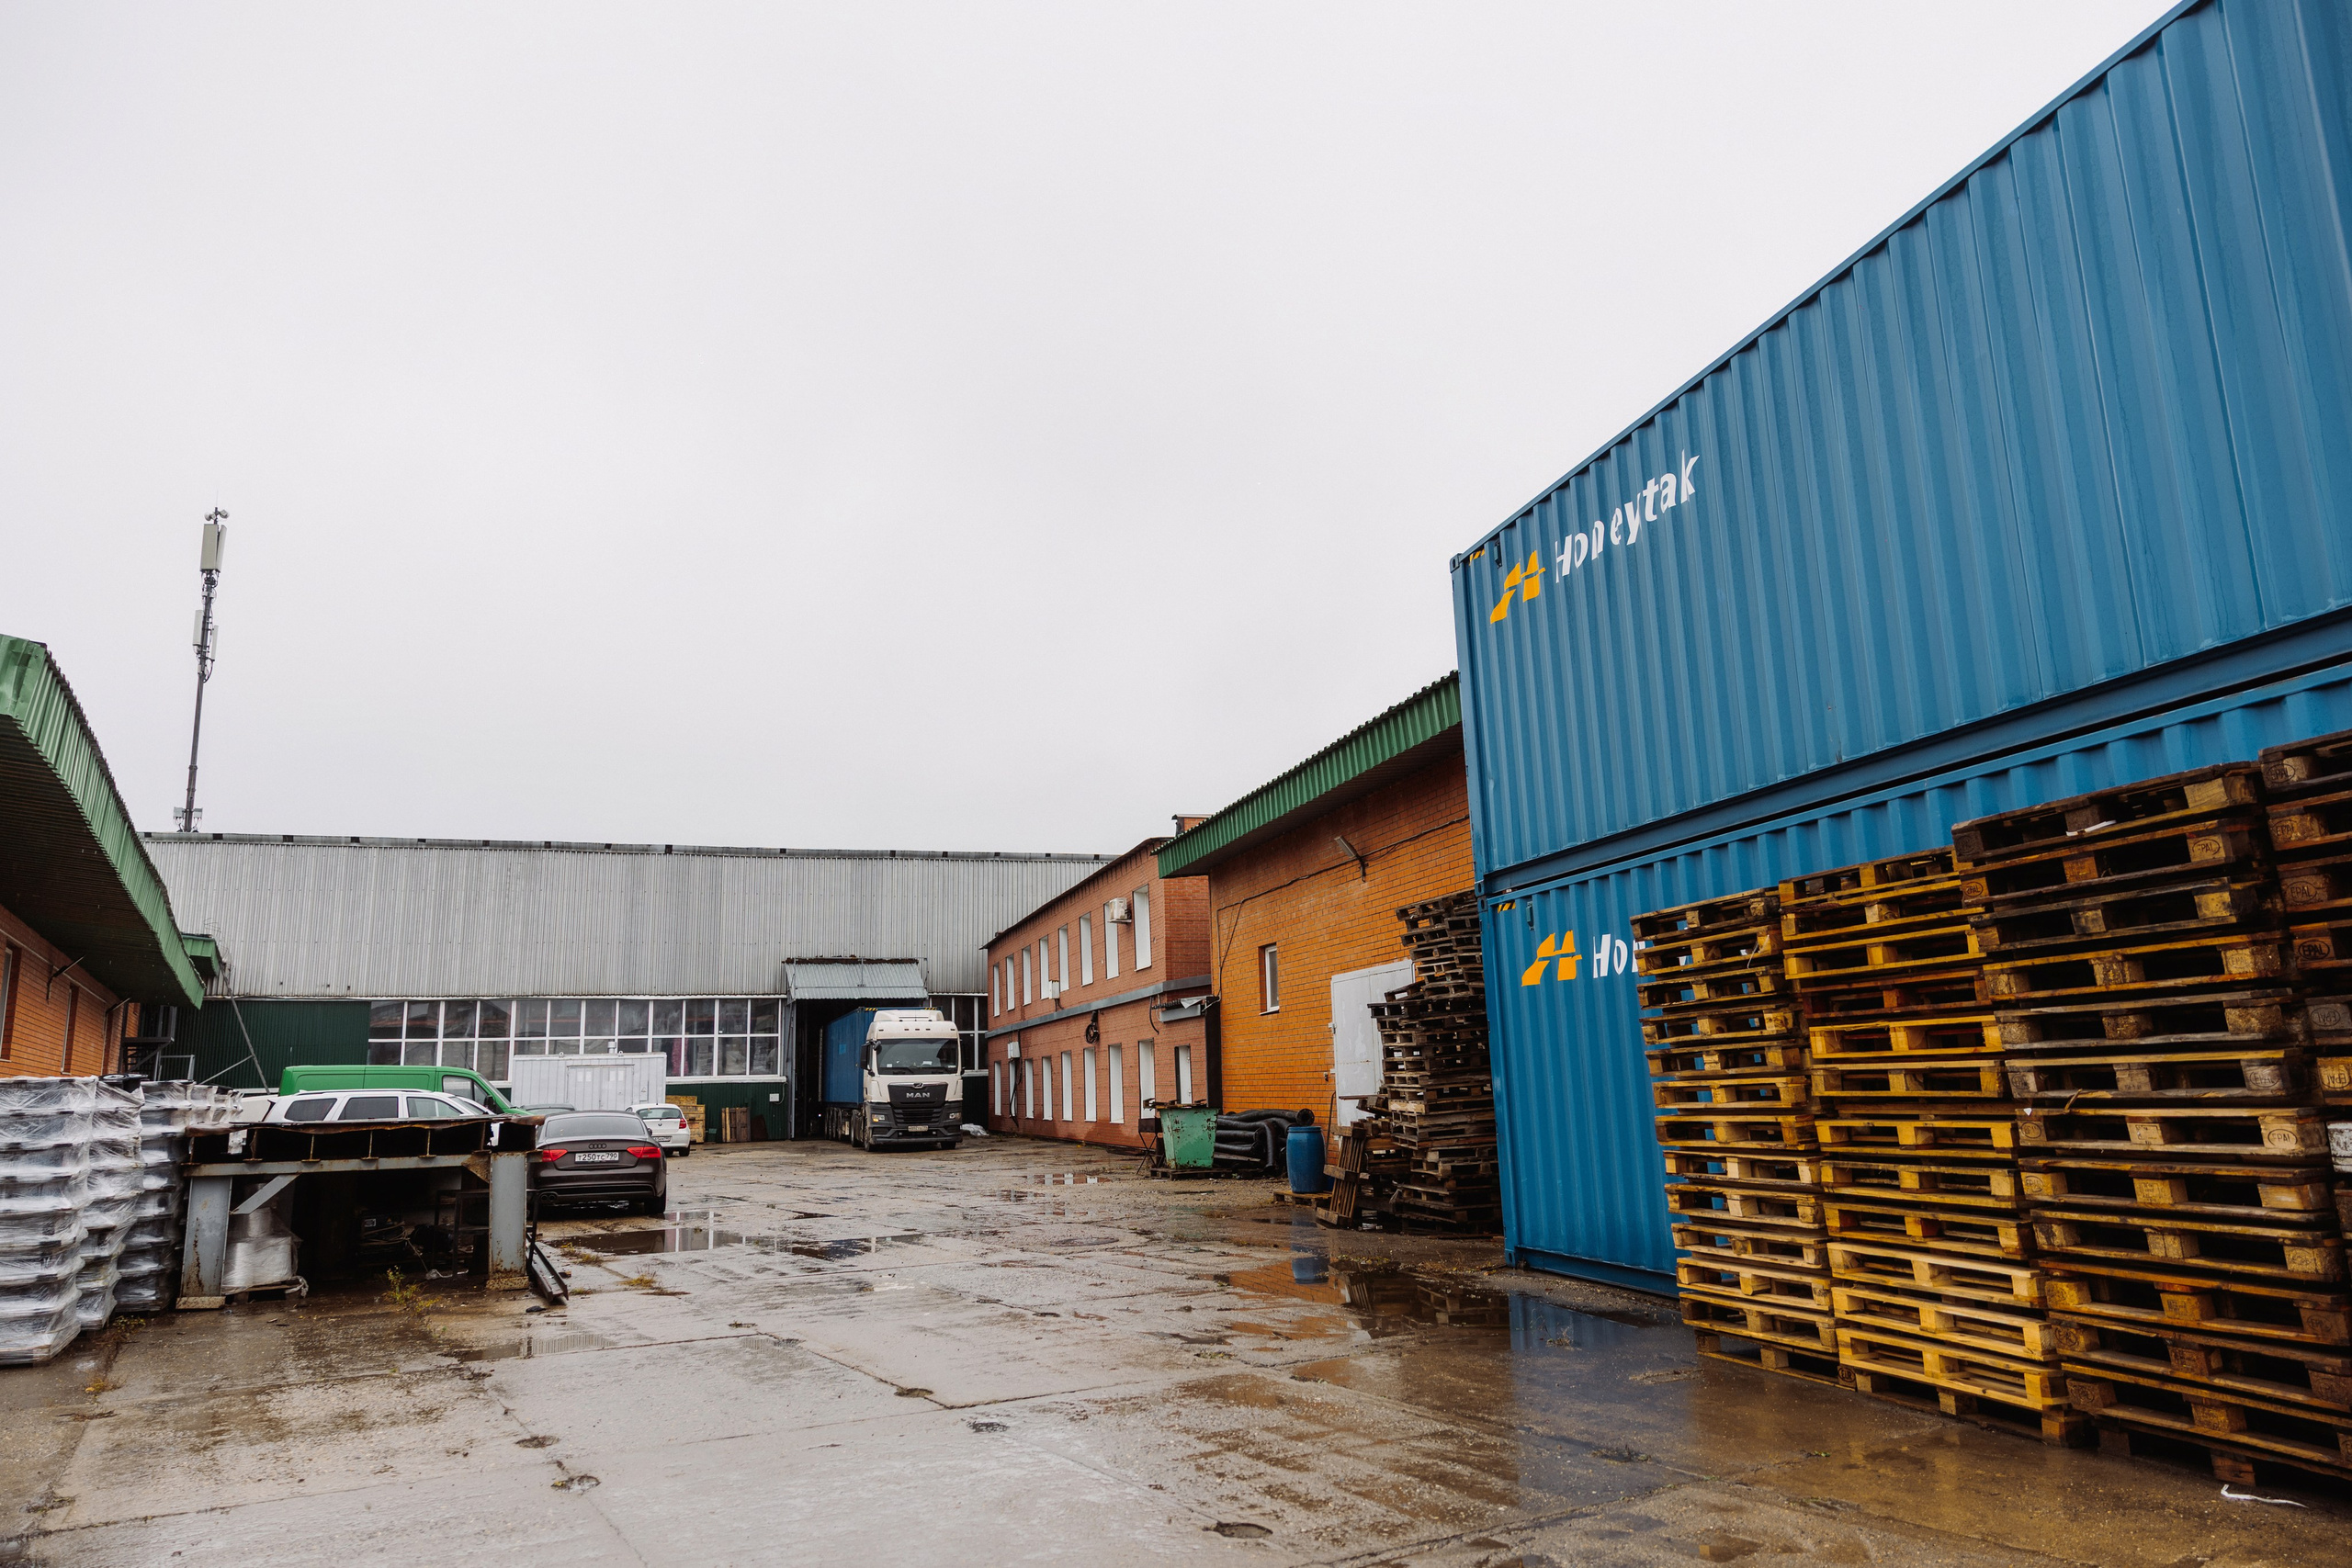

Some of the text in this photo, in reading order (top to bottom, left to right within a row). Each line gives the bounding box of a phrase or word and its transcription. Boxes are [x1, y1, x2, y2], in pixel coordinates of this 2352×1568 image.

[1555, 449, 1700, 583] Honeytak
[2290, 886, 2313, 899] EPAL
[2301, 944, 2326, 957] EPAL
